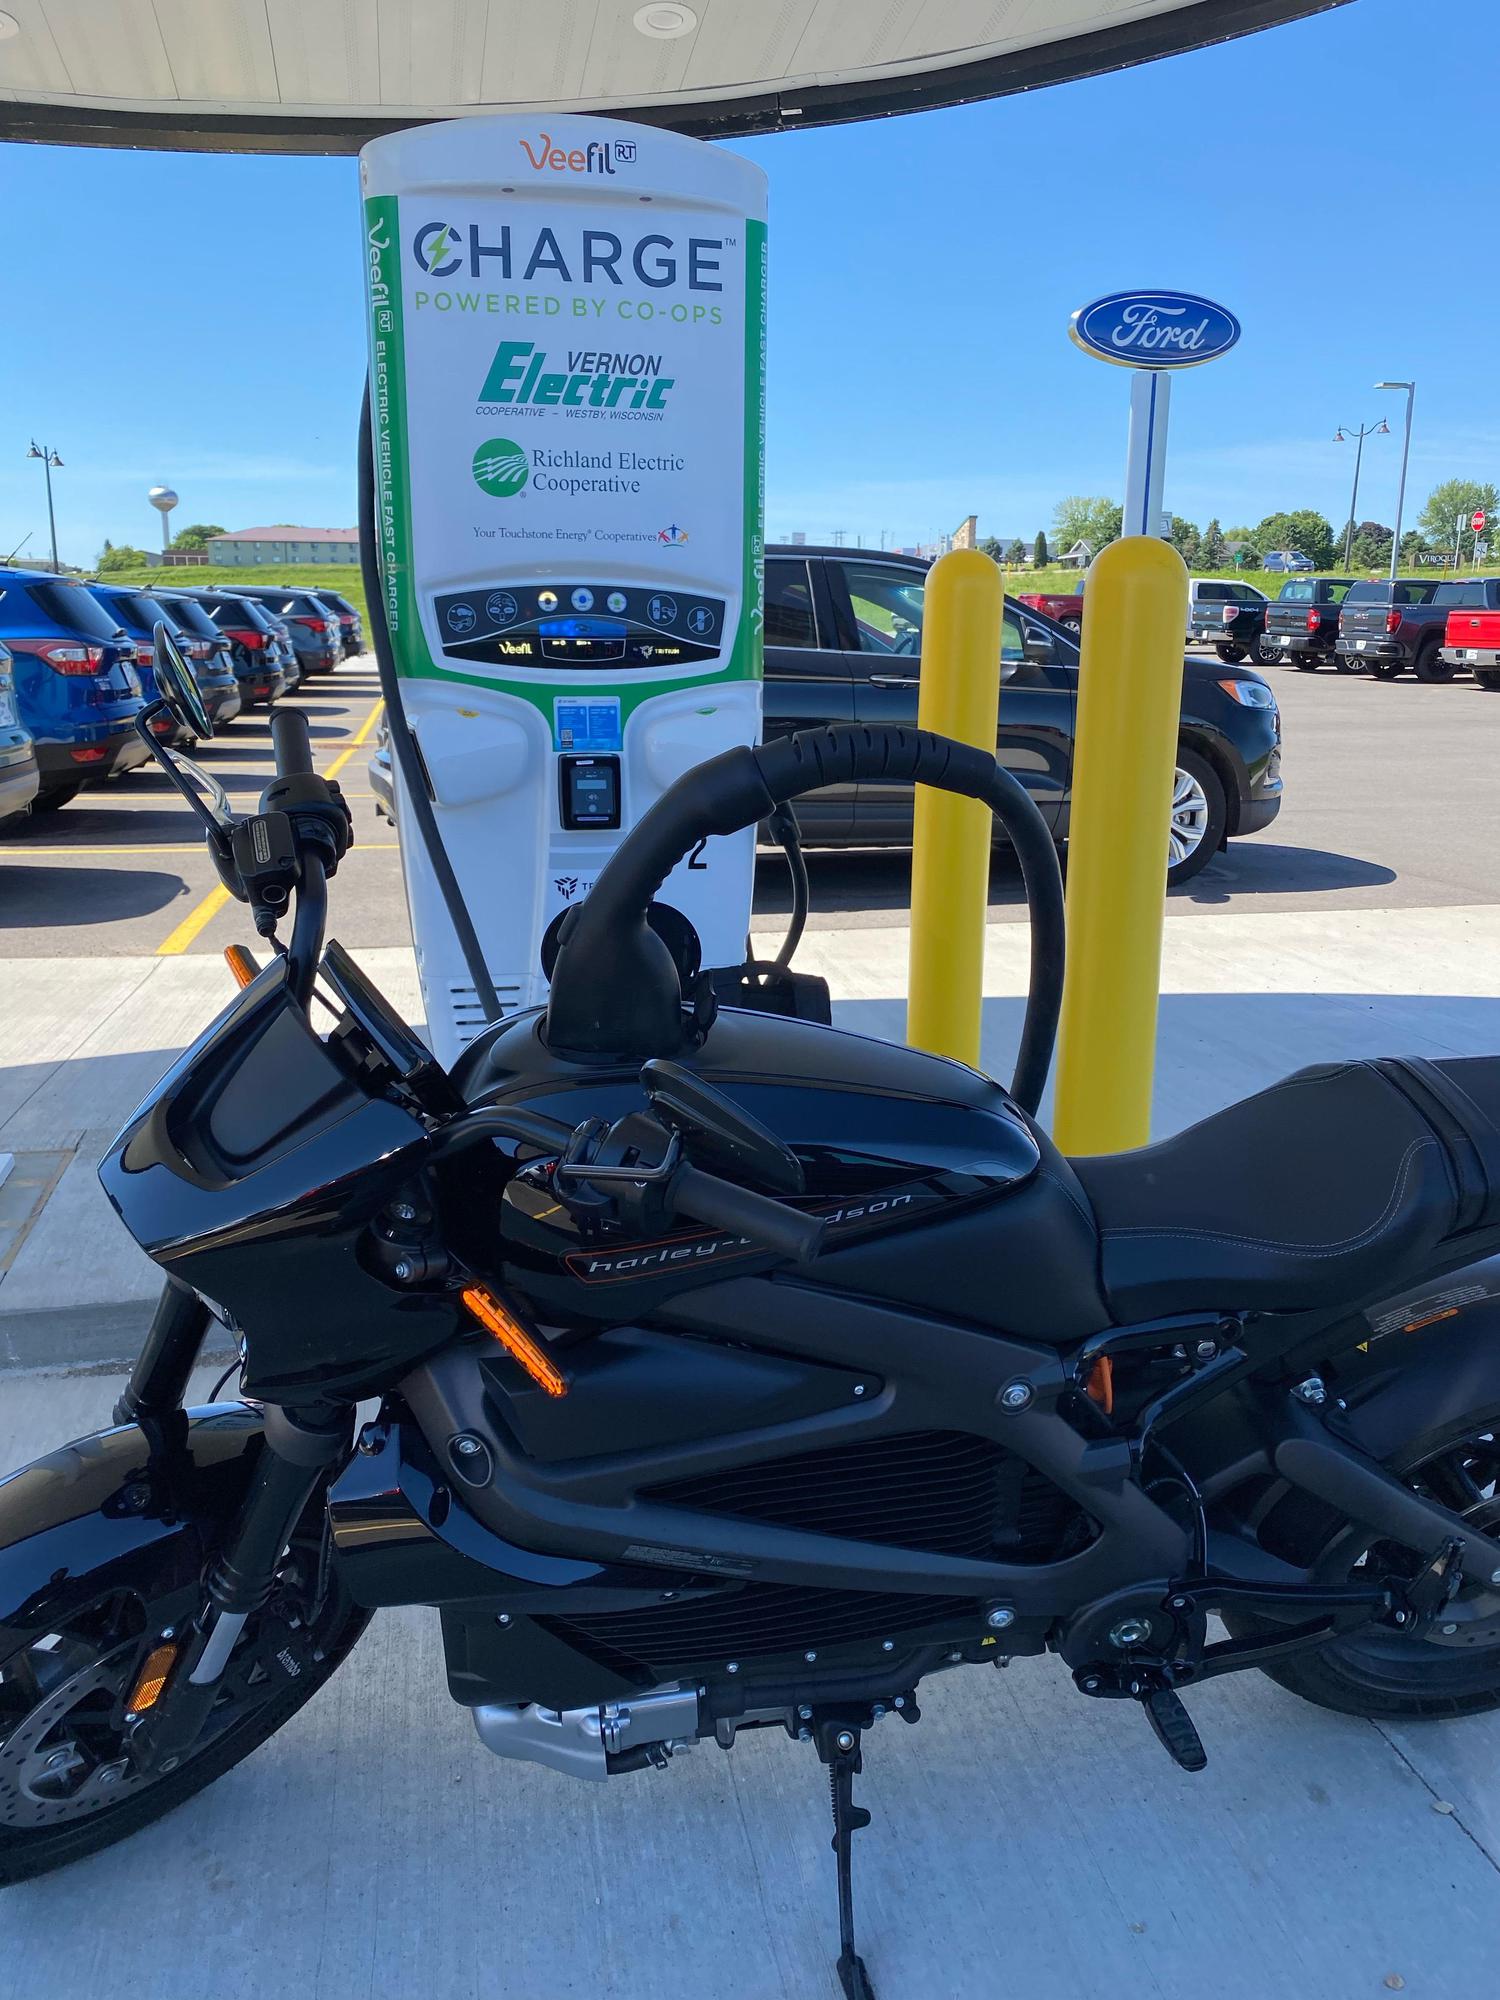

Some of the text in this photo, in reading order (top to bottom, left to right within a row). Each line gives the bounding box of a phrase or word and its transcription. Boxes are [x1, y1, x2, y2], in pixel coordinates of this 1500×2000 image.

[519, 133, 636, 175] Veefil RT
[368, 217, 390, 313] Veefil
[413, 221, 723, 292] CHARGE
[415, 291, 723, 325] POWERED BY CO-OPS
[1111, 303, 1210, 351] Ford
[376, 340, 389, 425] ELECTRIC
[477, 340, 676, 409] Electric
[566, 351, 663, 376] VERNON
[475, 406, 547, 418] COOPERATIVE
[565, 409, 607, 420] WESTBY,
[608, 411, 664, 421] WISCONSIN
[380, 429, 393, 501] VEHICLE
[532, 449, 685, 472] Richland Electric
[532, 473, 641, 496] Cooperative
[384, 506, 396, 547] FAST
[473, 527, 496, 538] Your
[499, 527, 553, 540] Touchstone
[595, 530, 657, 542] Cooperatives
[386, 551, 399, 632] CHARGER
[276, 1646, 301, 1677] brembo
